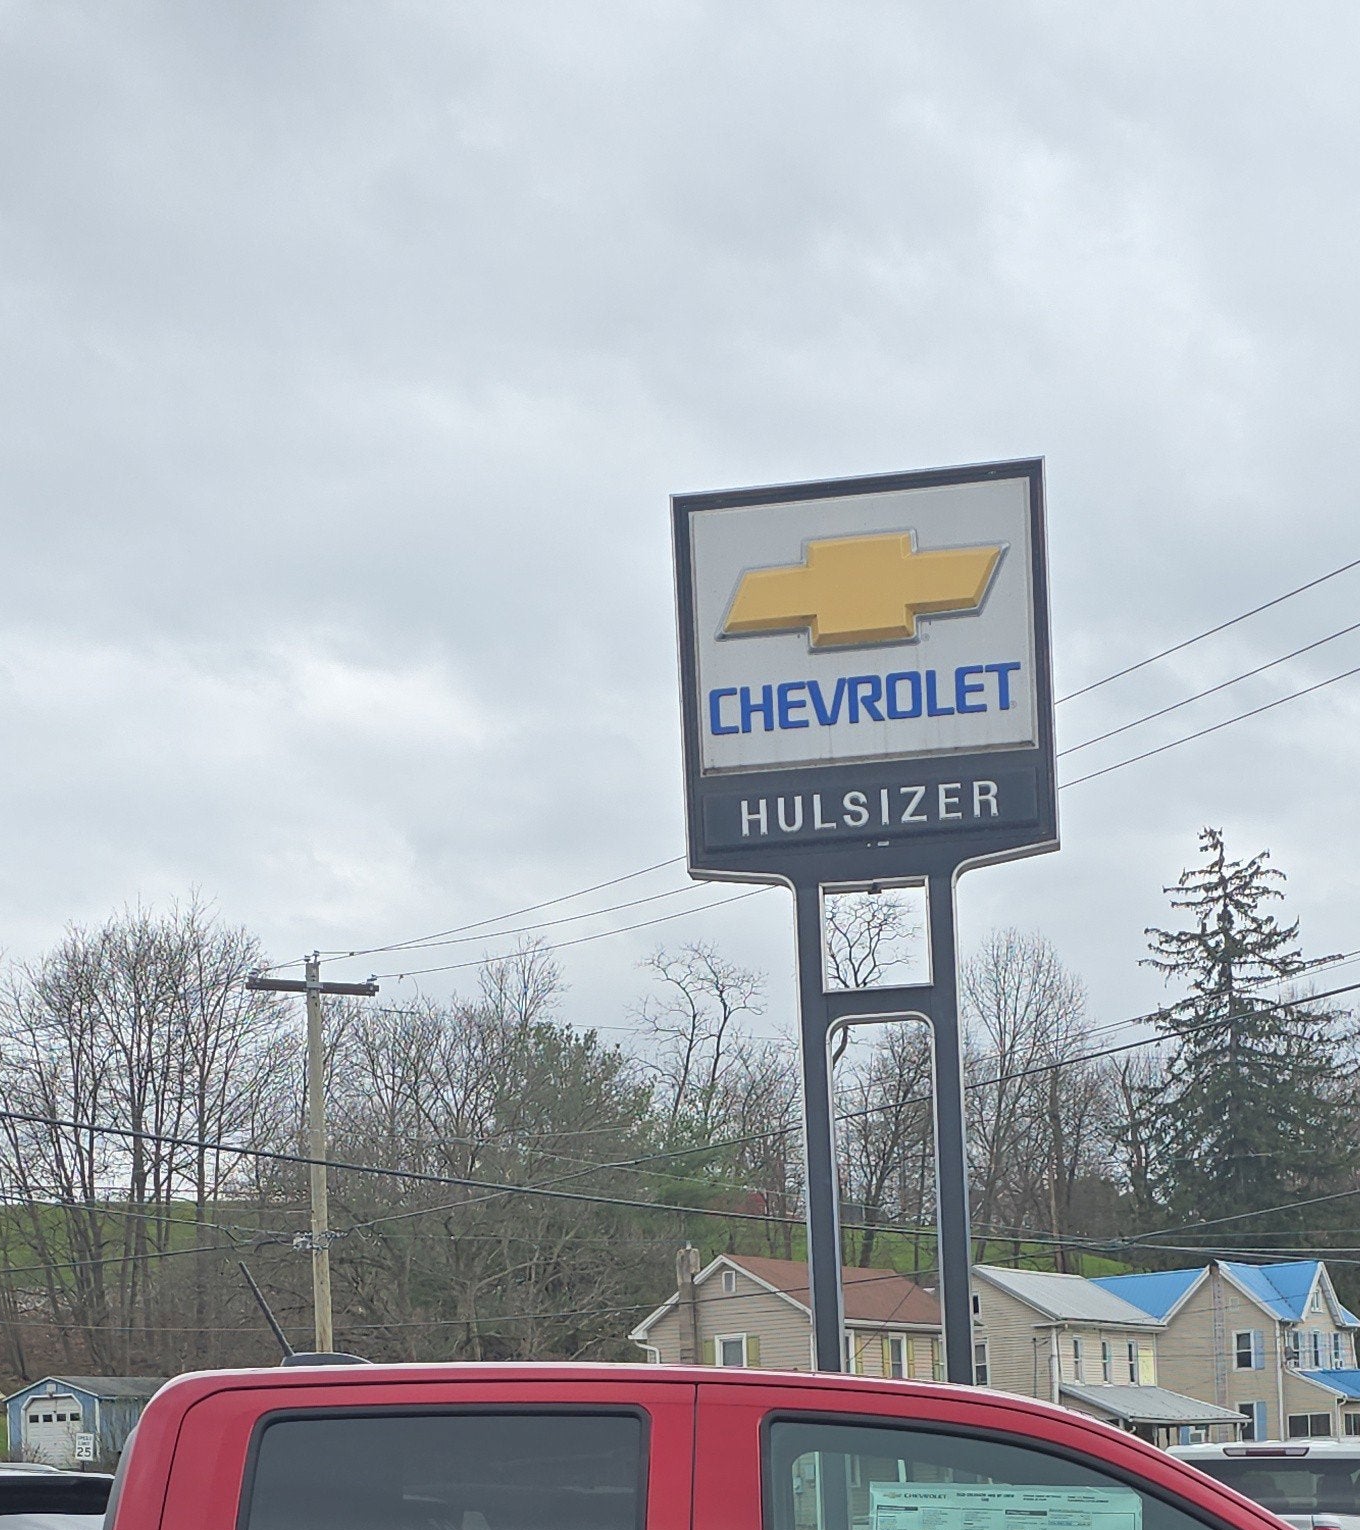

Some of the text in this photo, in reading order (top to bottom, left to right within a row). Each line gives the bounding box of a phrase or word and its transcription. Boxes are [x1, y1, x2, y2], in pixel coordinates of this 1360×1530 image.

[709, 661, 1022, 736] CHEVROLET
[740, 780, 1000, 837] HULSIZER
[77, 1446, 91, 1458] 25
